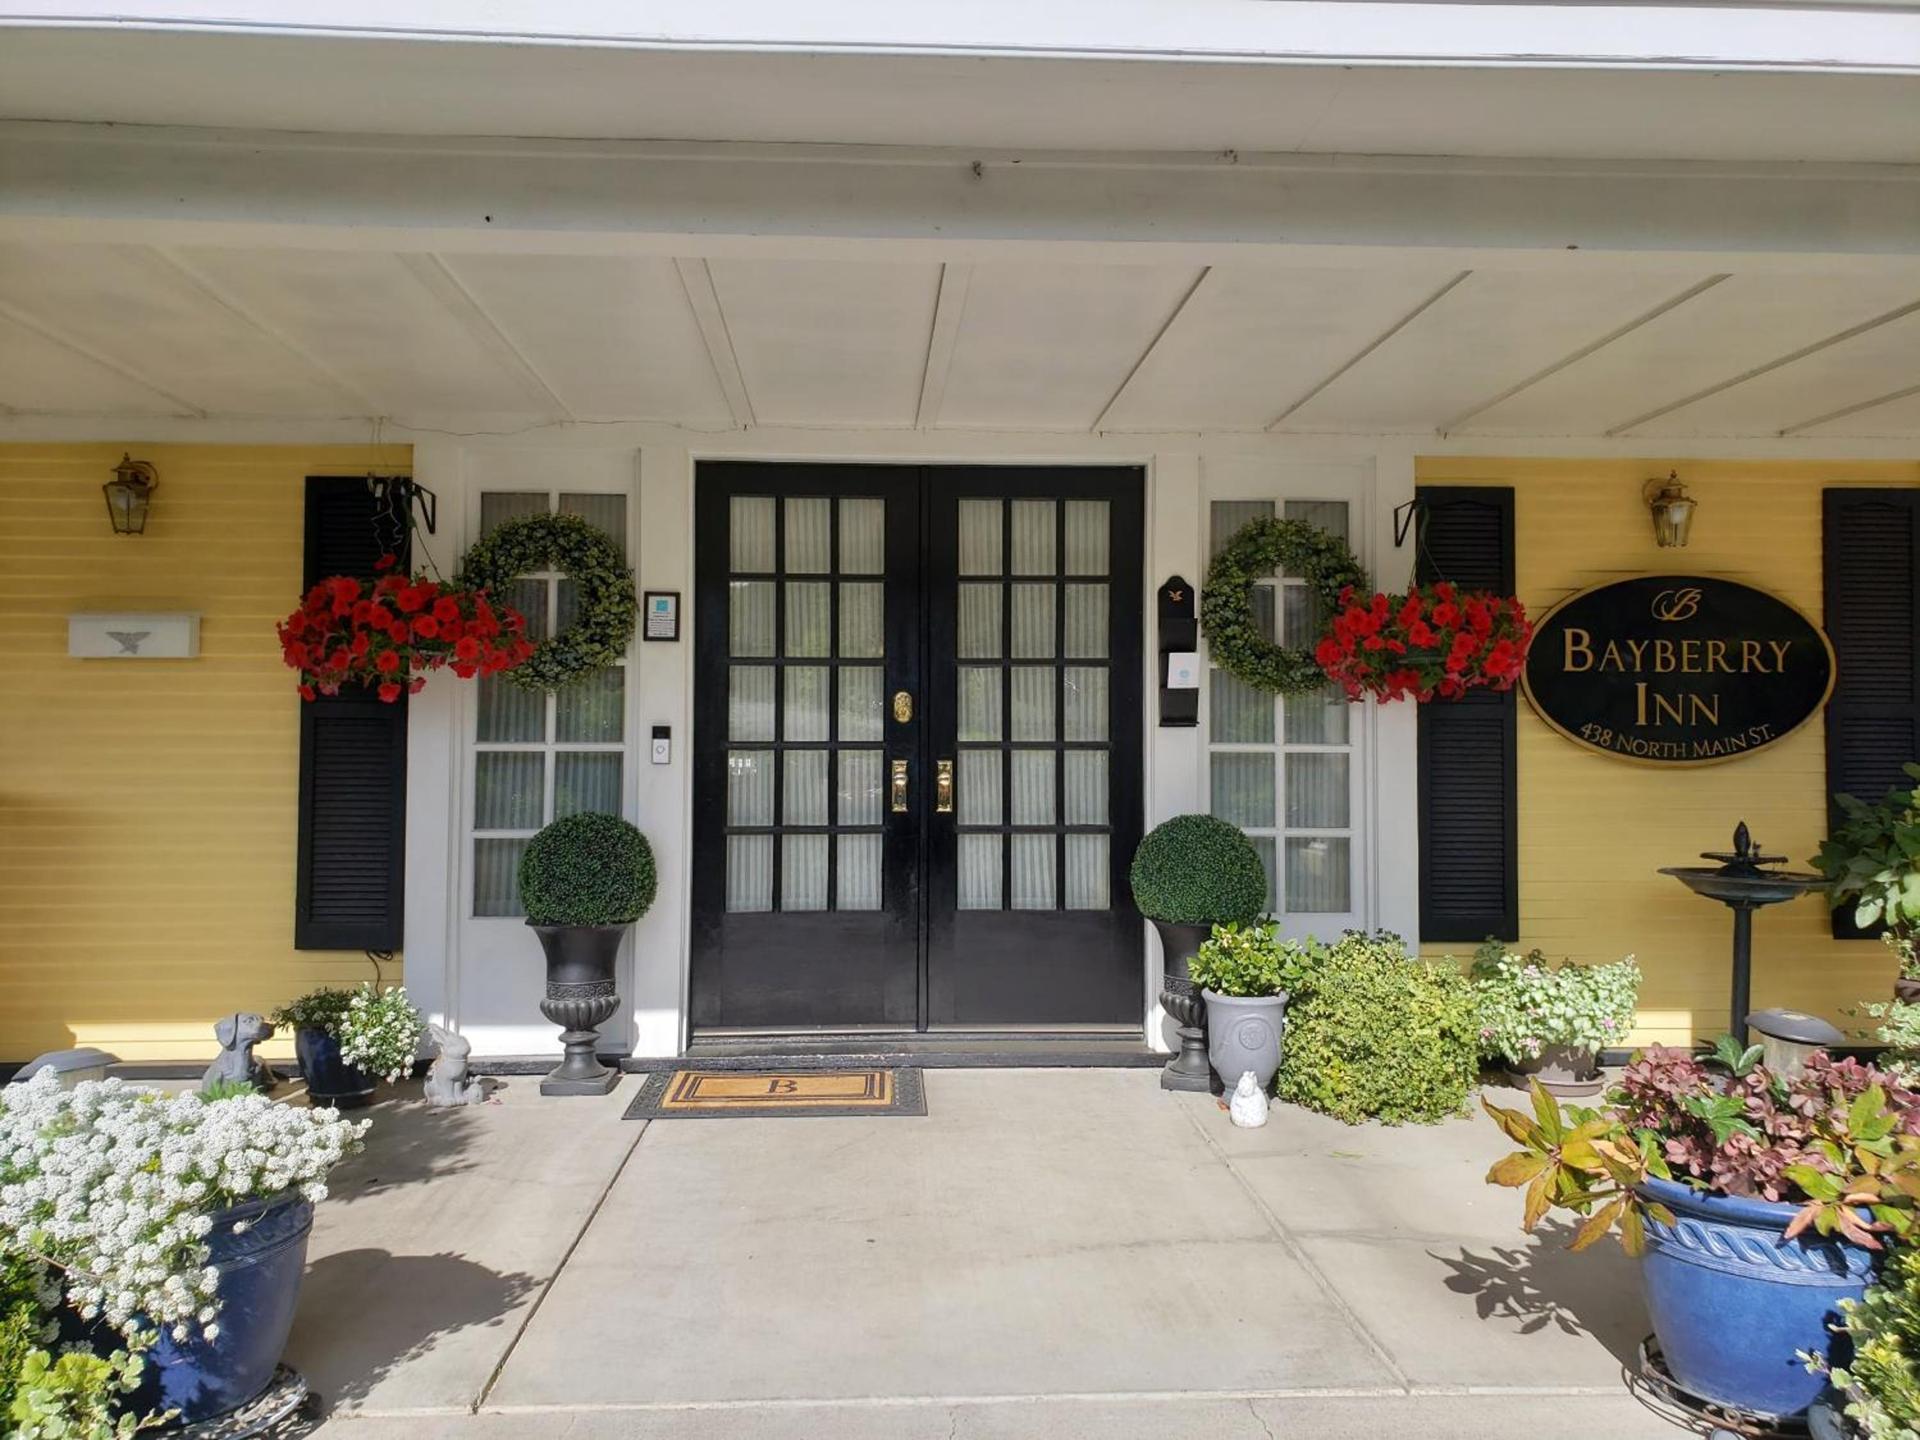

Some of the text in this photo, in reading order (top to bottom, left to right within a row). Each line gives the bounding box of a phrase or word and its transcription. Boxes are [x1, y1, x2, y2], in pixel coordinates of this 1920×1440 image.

[1651, 588, 1702, 621] B
[1563, 628, 1792, 673] BAYBERRY
[1635, 682, 1719, 726] INN
[1580, 722, 1776, 758] 438 NORTH MAIN ST.
[766, 1079, 798, 1094] B
